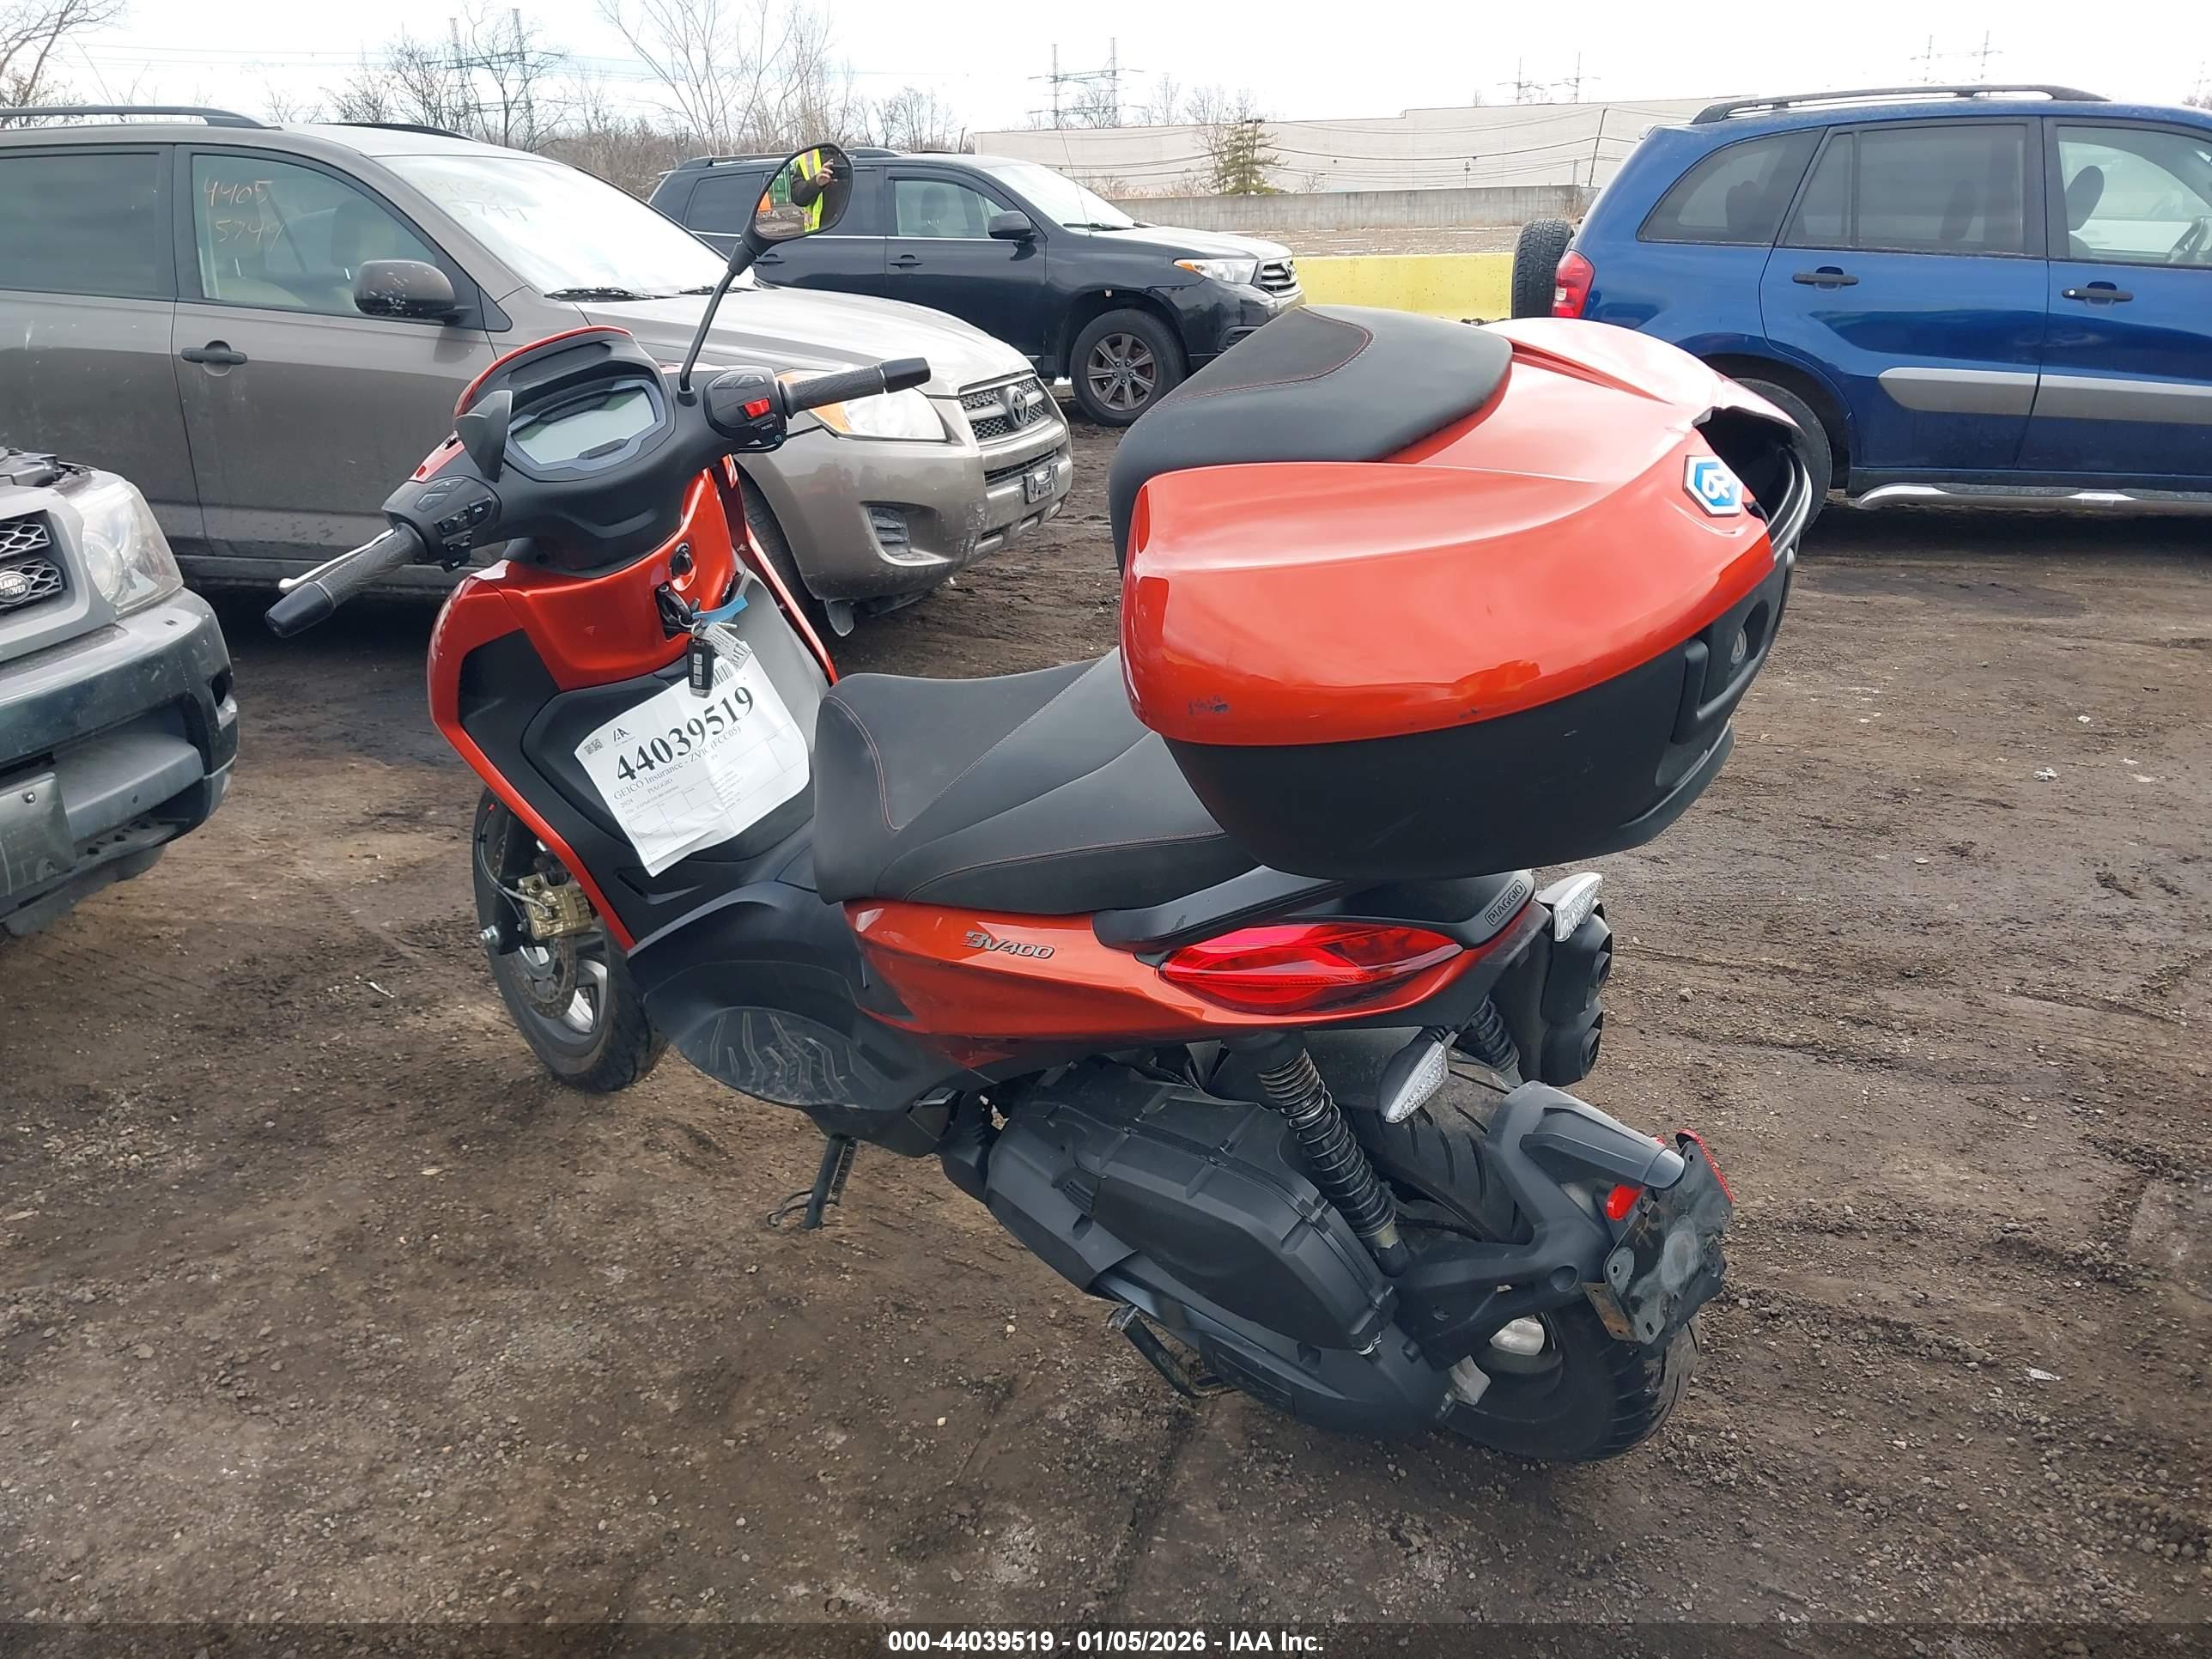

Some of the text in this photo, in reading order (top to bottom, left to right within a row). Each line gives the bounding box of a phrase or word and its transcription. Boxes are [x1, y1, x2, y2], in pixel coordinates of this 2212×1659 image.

[617, 686, 754, 781] 44039519
[613, 779, 644, 799] GEICO
[644, 761, 684, 784] Insurance
[1487, 884, 1523, 923] PIAGGIO
